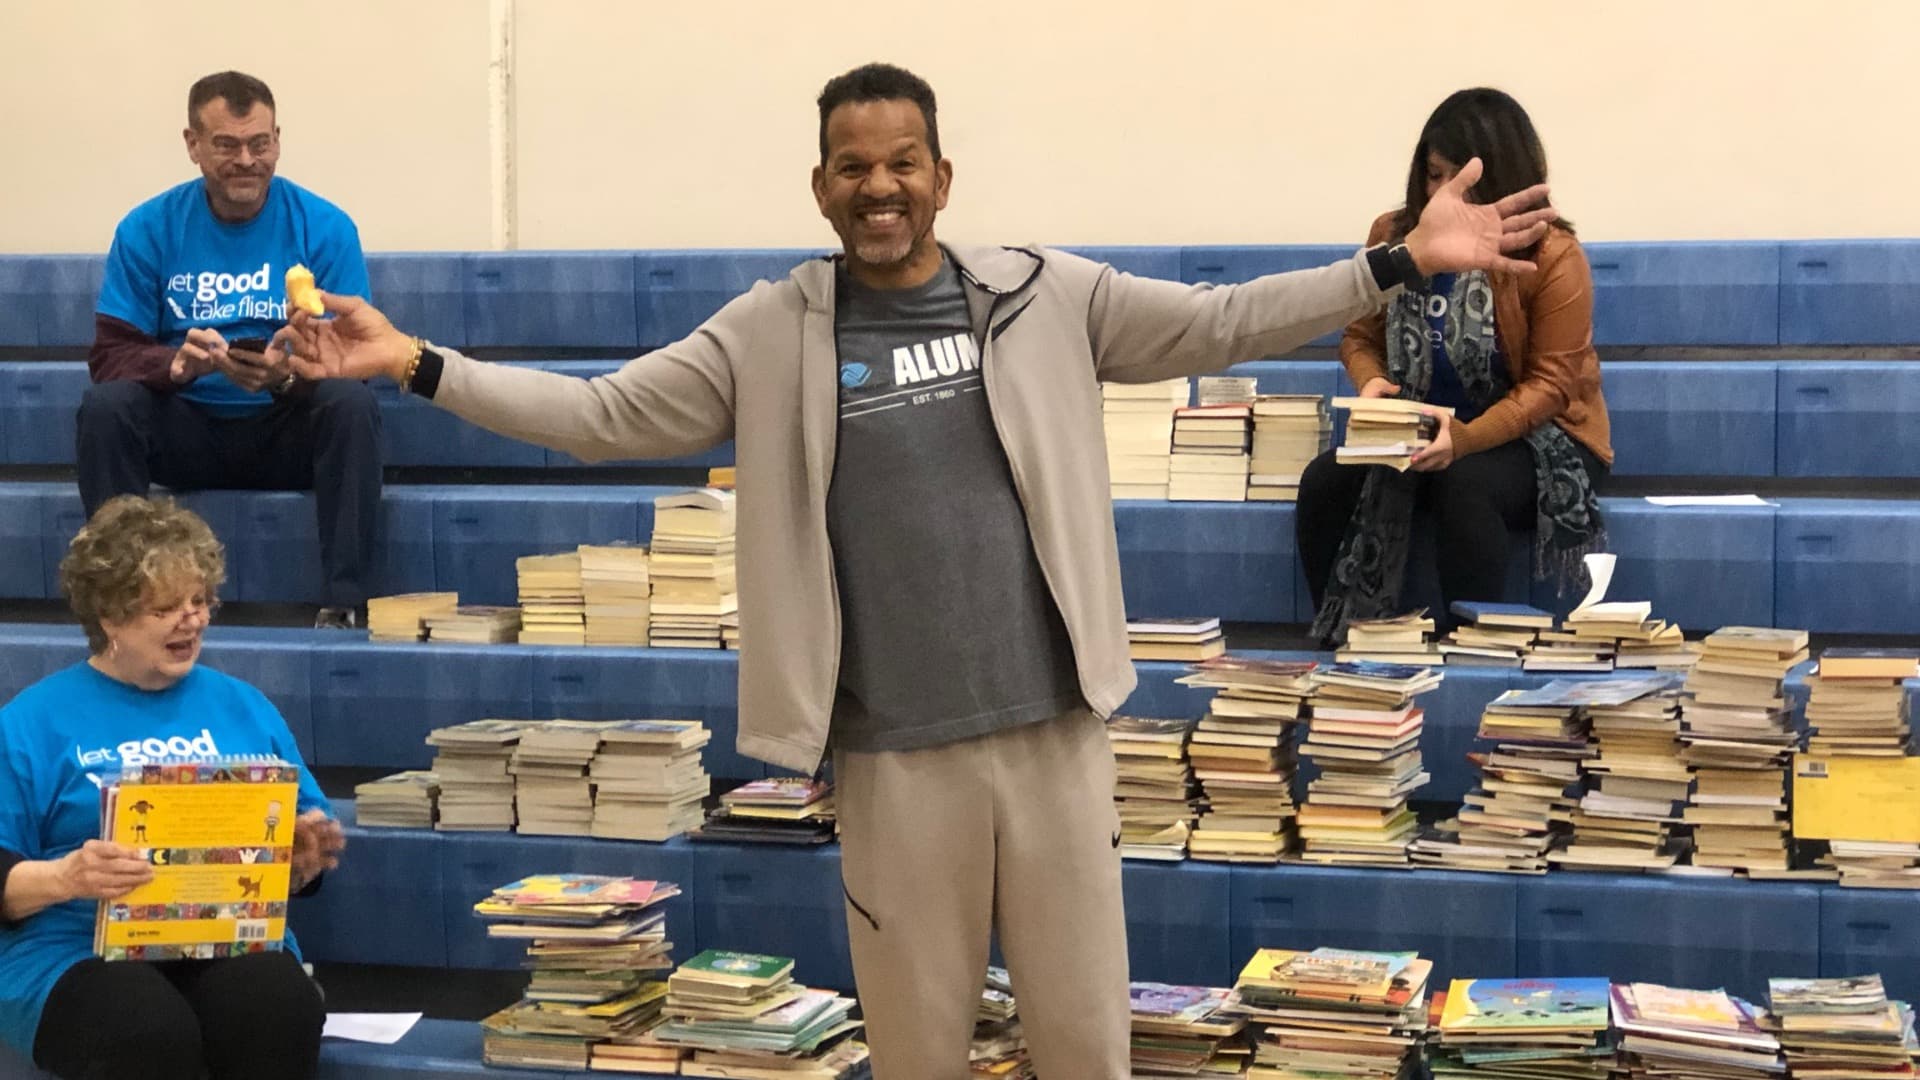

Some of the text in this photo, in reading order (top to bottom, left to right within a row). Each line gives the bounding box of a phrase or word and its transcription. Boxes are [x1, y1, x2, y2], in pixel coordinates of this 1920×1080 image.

[196, 263, 270, 302] good
[190, 295, 288, 321] take flight
[76, 728, 220, 768] let good
